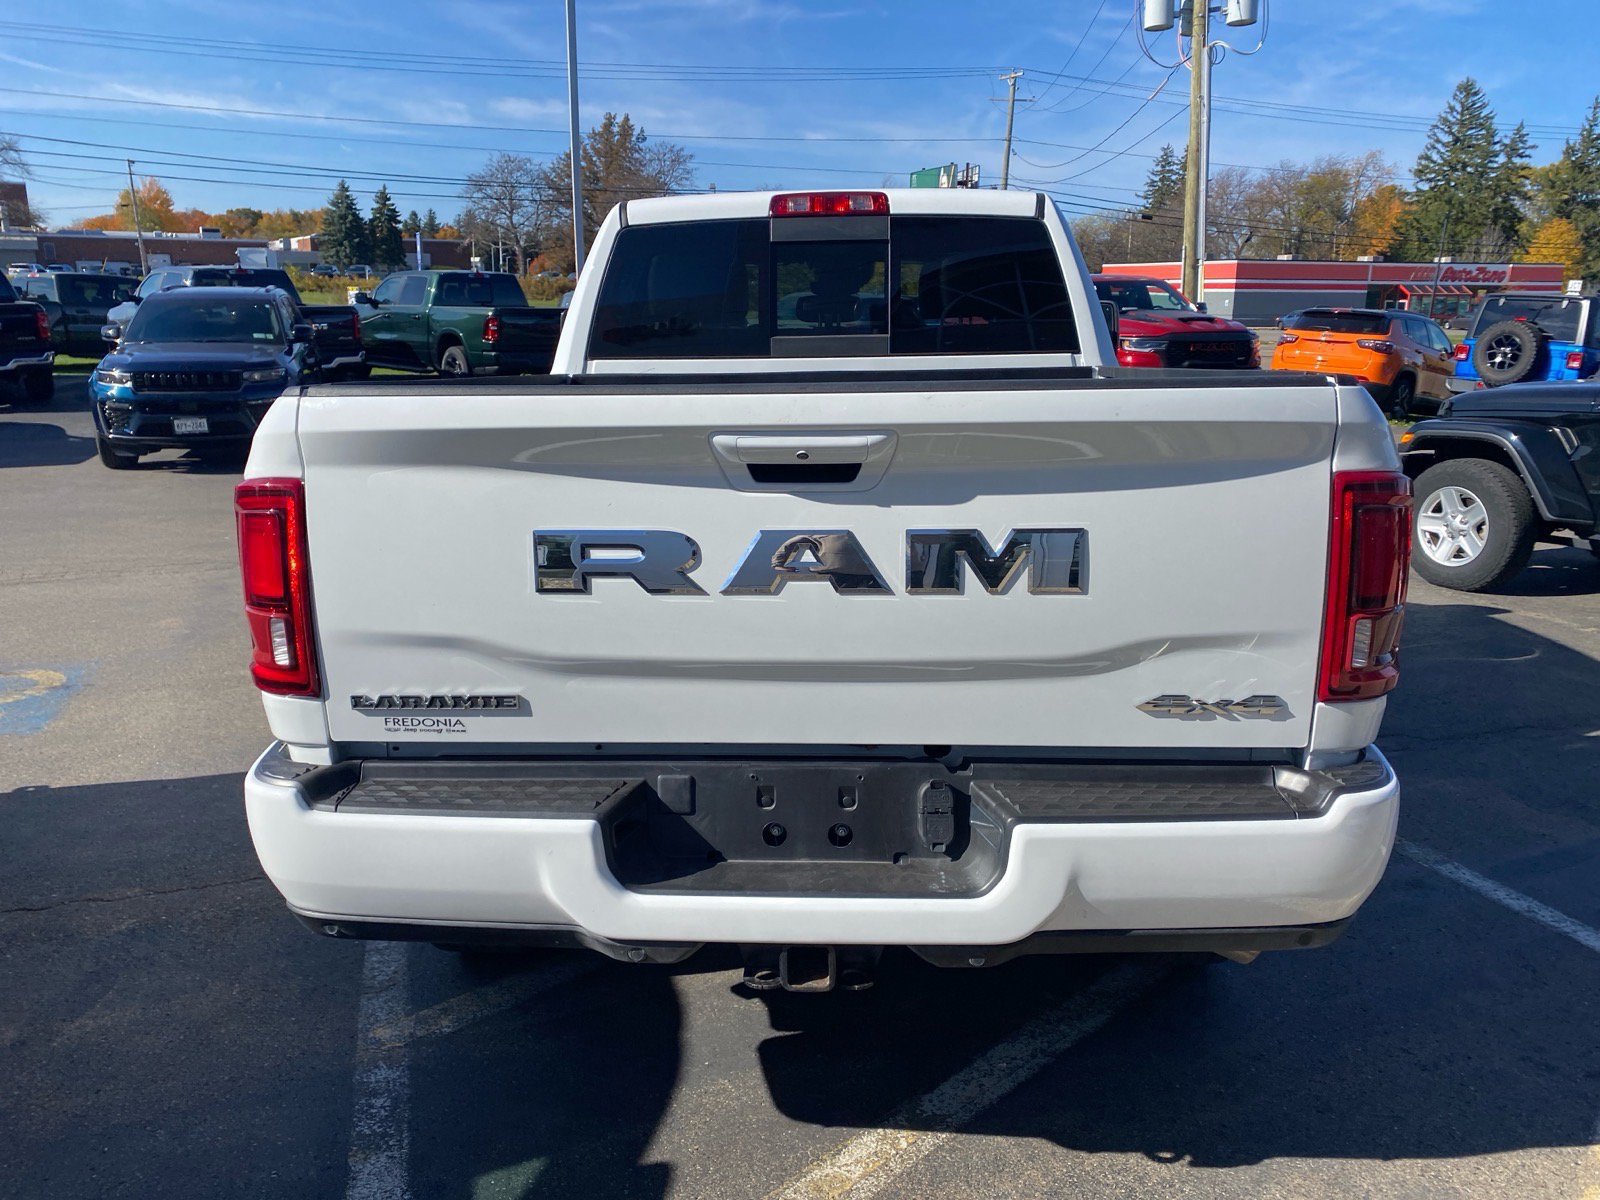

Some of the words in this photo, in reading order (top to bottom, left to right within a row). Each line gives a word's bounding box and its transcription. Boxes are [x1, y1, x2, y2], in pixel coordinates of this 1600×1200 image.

[1439, 266, 1507, 283] AutoZone
[532, 527, 1090, 596] RAM
[350, 694, 520, 710] LARAMIE
[384, 717, 466, 728] FREDONIA
